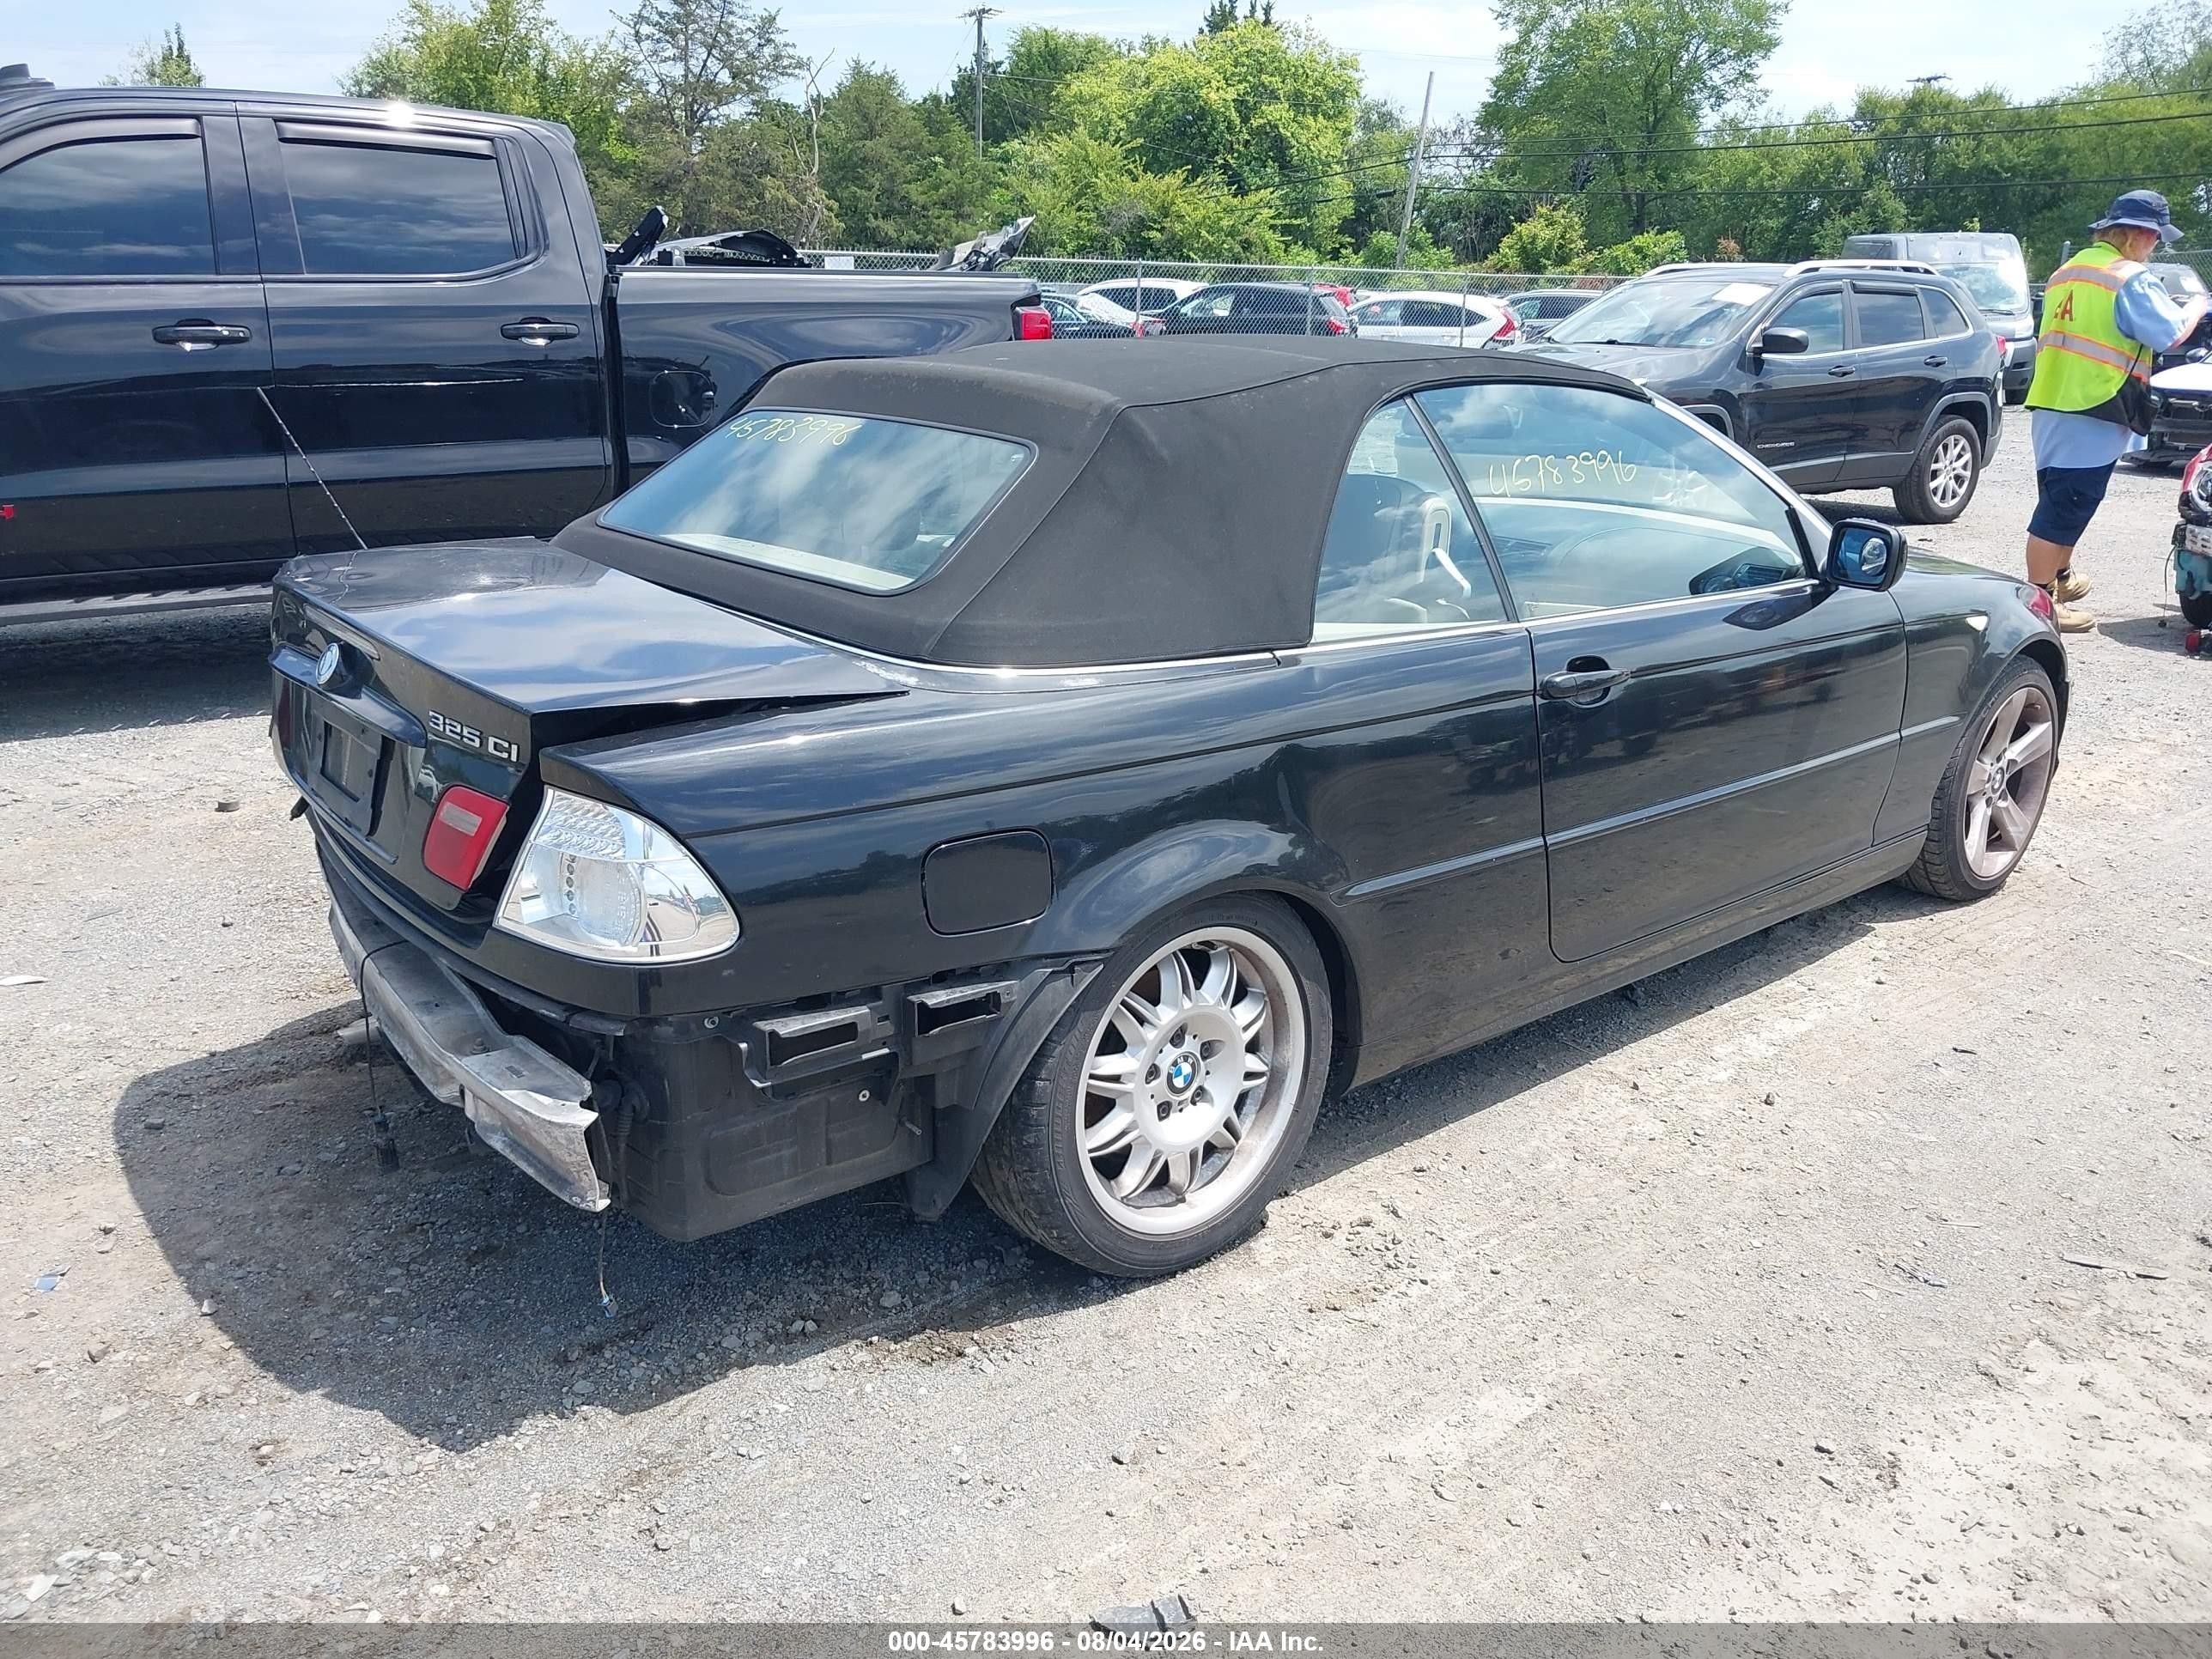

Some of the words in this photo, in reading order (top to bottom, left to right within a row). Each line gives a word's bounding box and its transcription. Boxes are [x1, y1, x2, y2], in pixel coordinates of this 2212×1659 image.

[725, 416, 863, 446] 45783996
[1488, 449, 1638, 498] 45783996
[428, 709, 482, 749] 325
